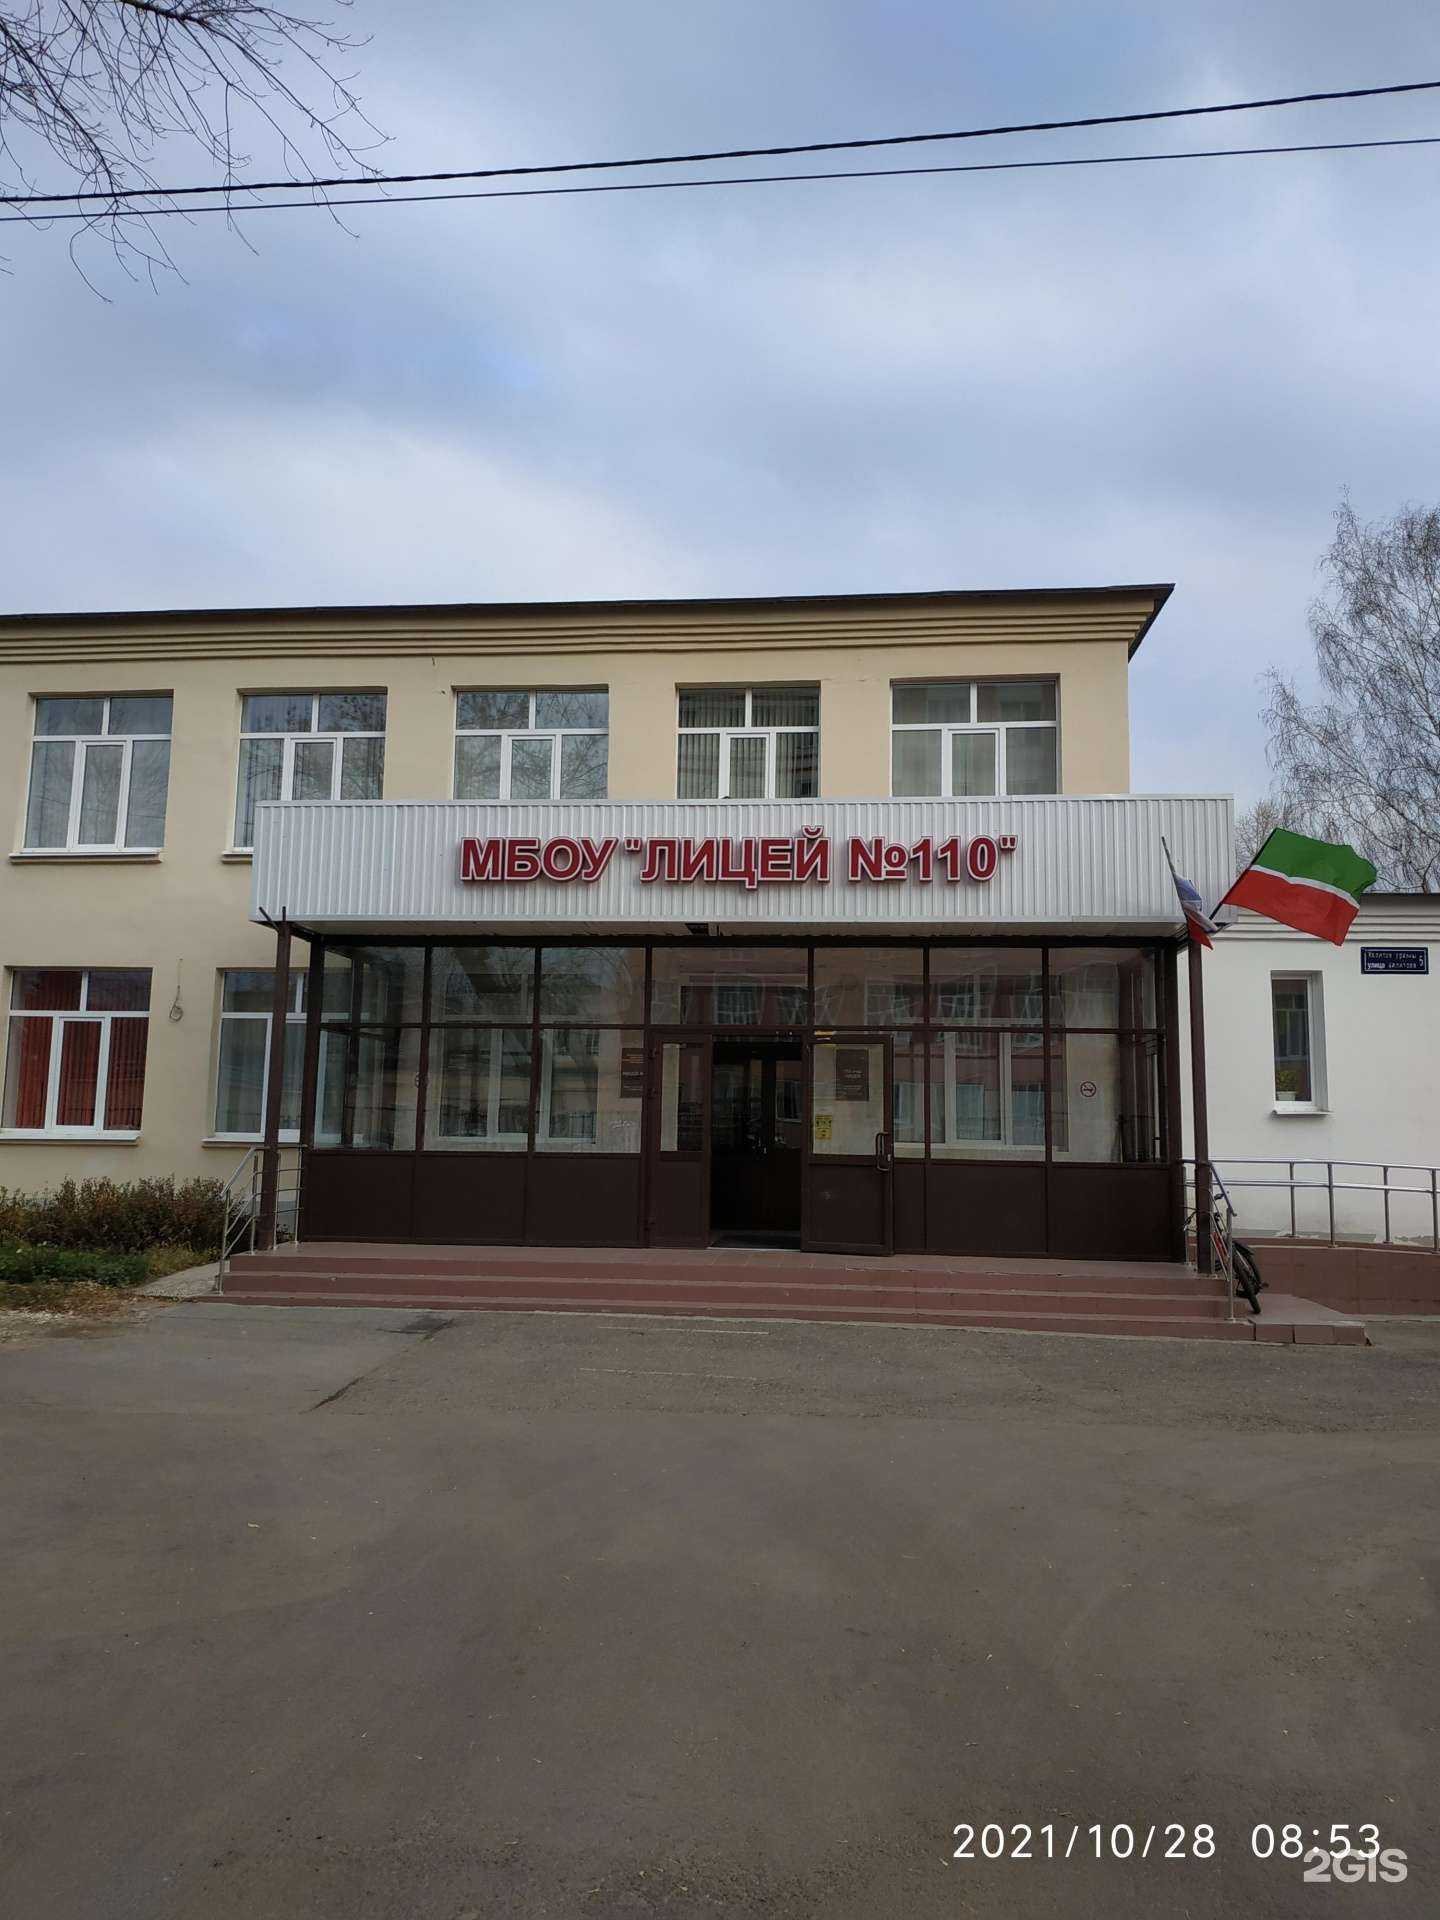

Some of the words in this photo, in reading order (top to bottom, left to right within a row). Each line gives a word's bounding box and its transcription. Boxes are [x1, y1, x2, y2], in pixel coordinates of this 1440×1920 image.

[460, 836, 618, 882] МБОУ
[624, 824, 831, 889] "ЛИЦЕЙ
[847, 835, 1018, 882] №110"
